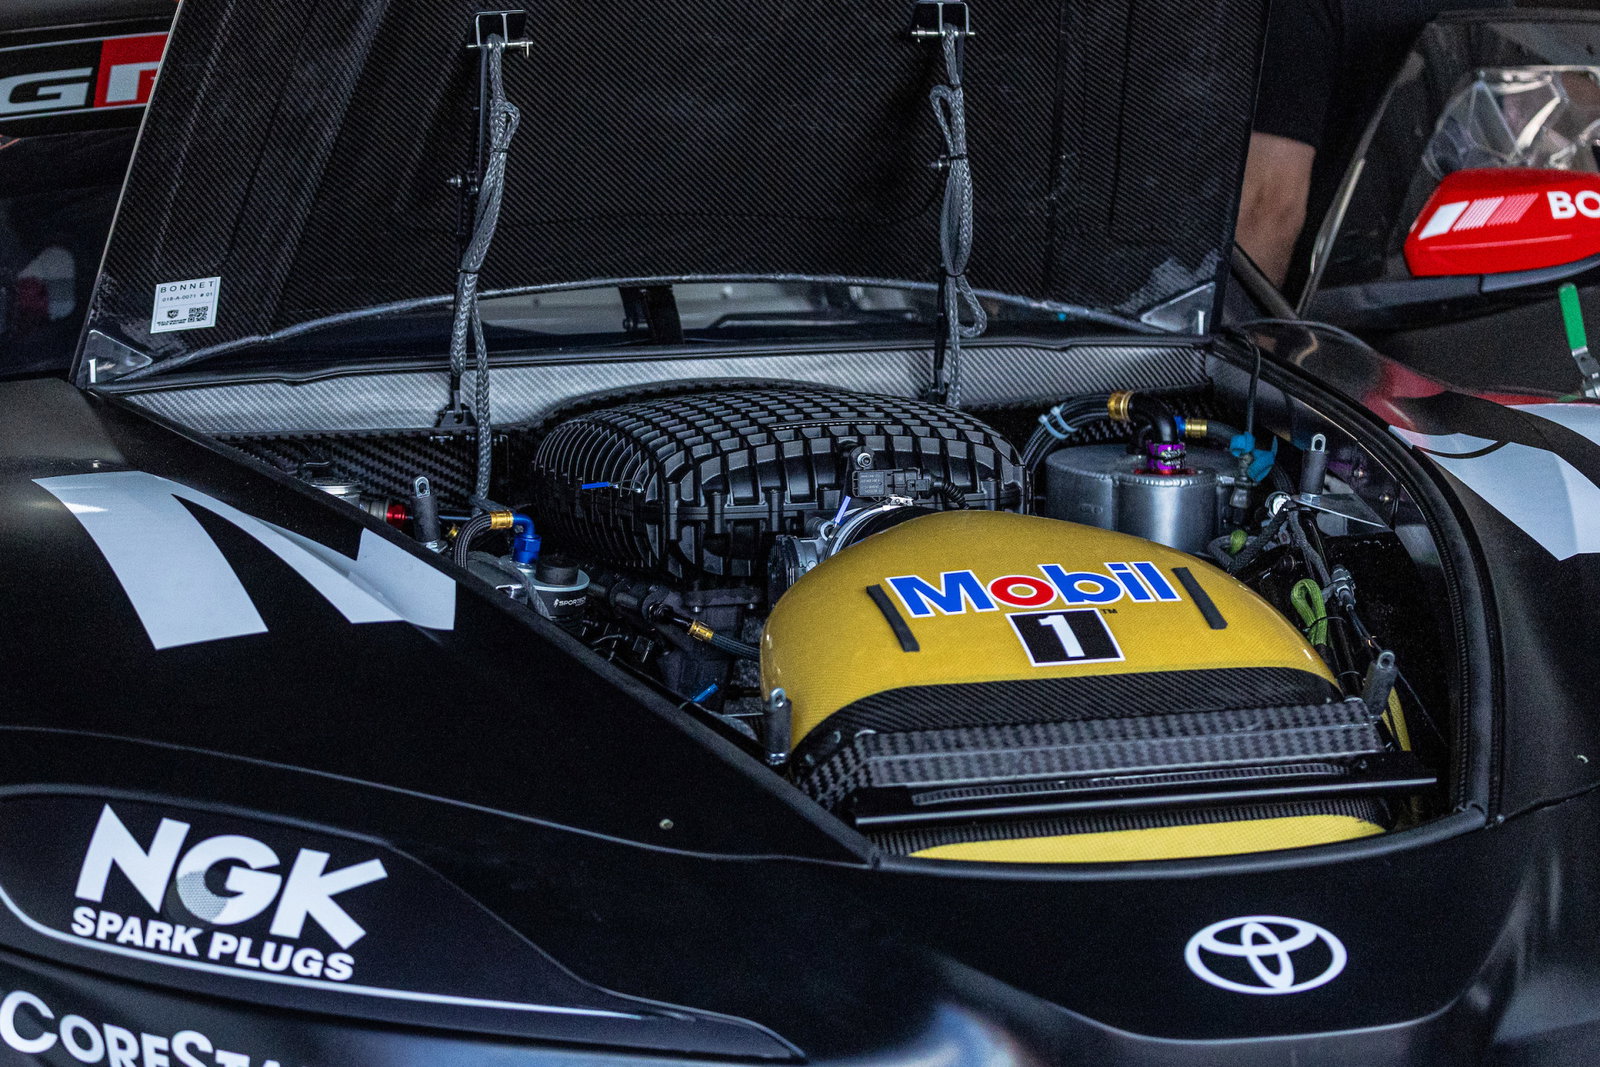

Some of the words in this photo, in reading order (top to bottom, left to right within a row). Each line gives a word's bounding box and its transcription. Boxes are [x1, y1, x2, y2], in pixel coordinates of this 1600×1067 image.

[160, 281, 214, 293] BONNET
[885, 561, 1182, 618] Mobil
[1038, 614, 1086, 658] 1
[75, 803, 388, 950] NGK
[71, 906, 204, 956] SPARK
[208, 932, 355, 981] PLUGS
[0, 990, 281, 1067] CORES
